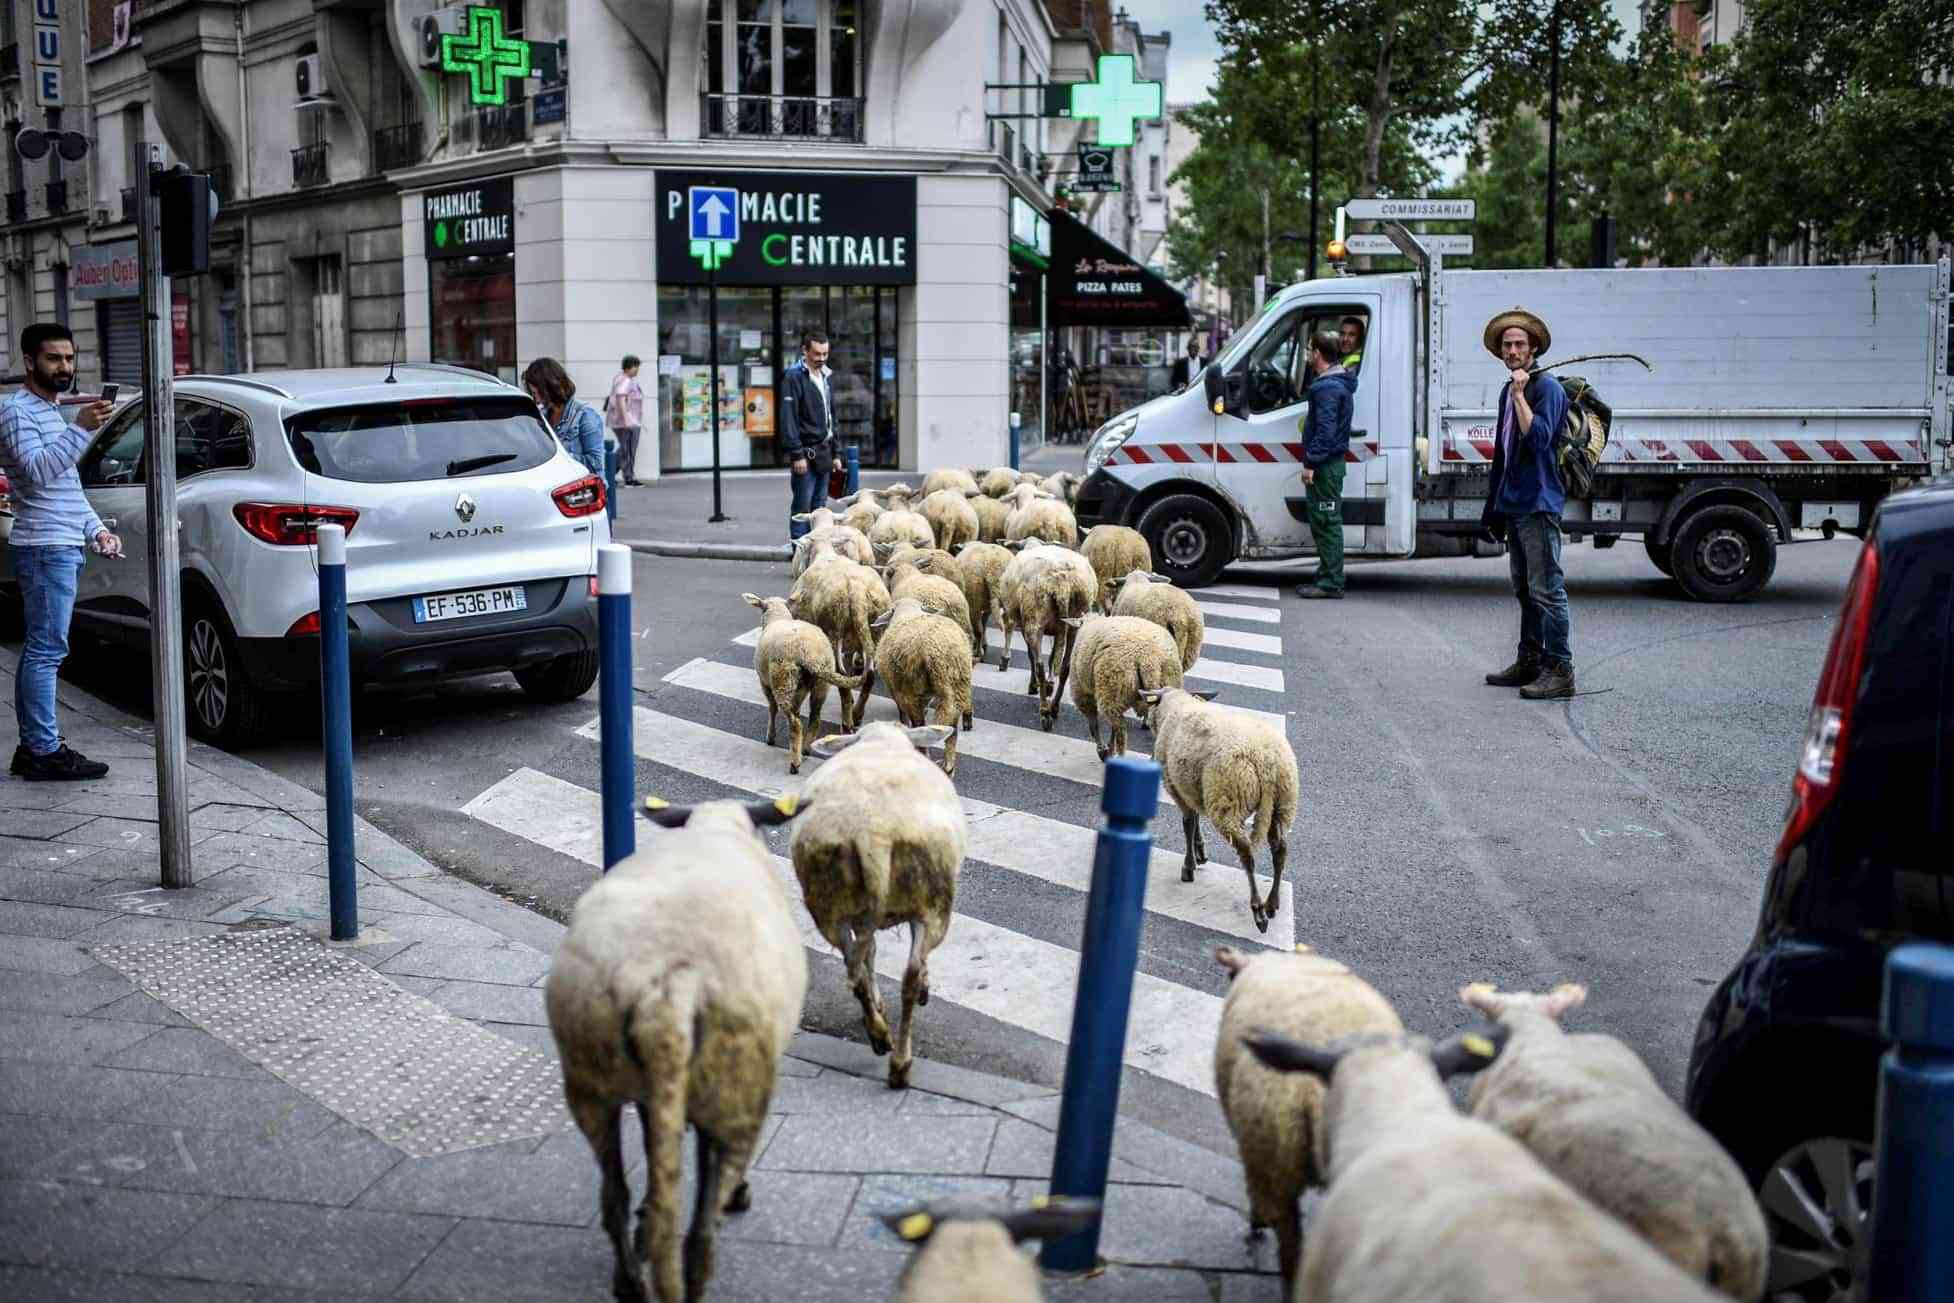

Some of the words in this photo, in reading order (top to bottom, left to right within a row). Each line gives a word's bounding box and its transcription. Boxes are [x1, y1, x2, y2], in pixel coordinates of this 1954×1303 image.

[427, 190, 482, 220] PHARMACIE
[667, 190, 822, 223] PMACIE
[1381, 204, 1470, 216] COMMISSARIAT
[454, 214, 508, 245] CENTRALE
[762, 234, 906, 266] CENTRALE
[112, 255, 138, 288] Opti
[1077, 281, 1107, 293] PIZZA
[1110, 281, 1142, 293] PATES
[429, 525, 505, 541] KADJAR
